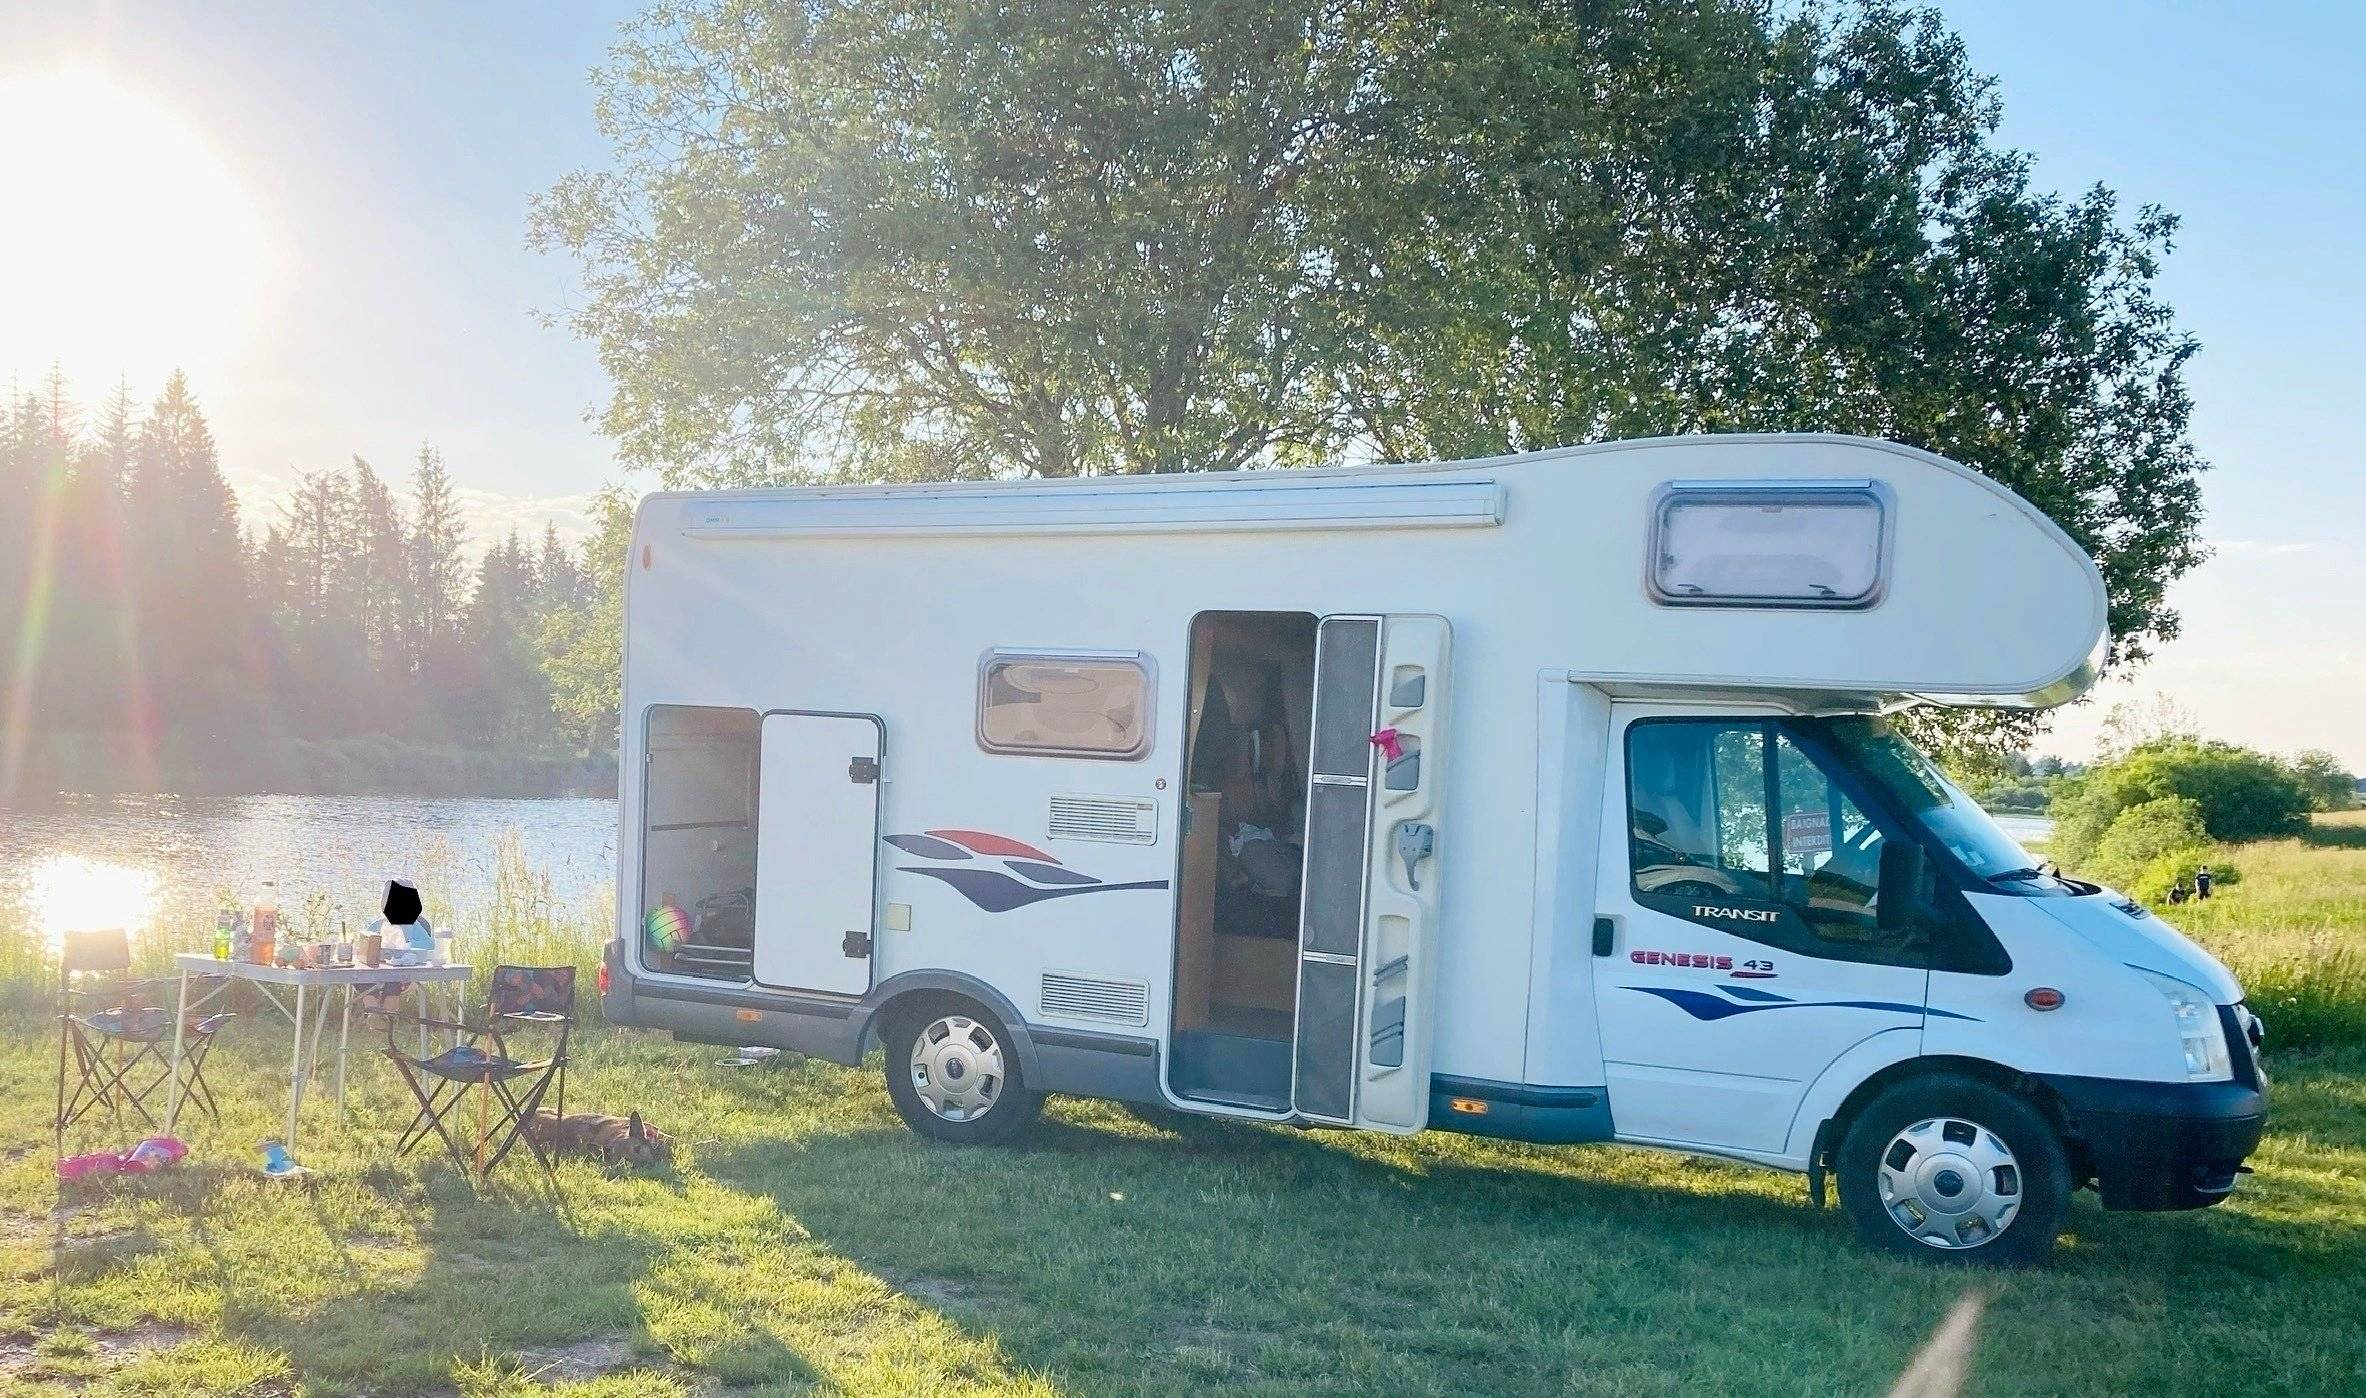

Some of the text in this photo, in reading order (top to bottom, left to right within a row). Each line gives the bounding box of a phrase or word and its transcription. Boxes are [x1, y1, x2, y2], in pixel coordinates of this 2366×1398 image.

[1692, 905, 1780, 922] TRANSIT
[1630, 950, 1774, 971] GENESIS 43
